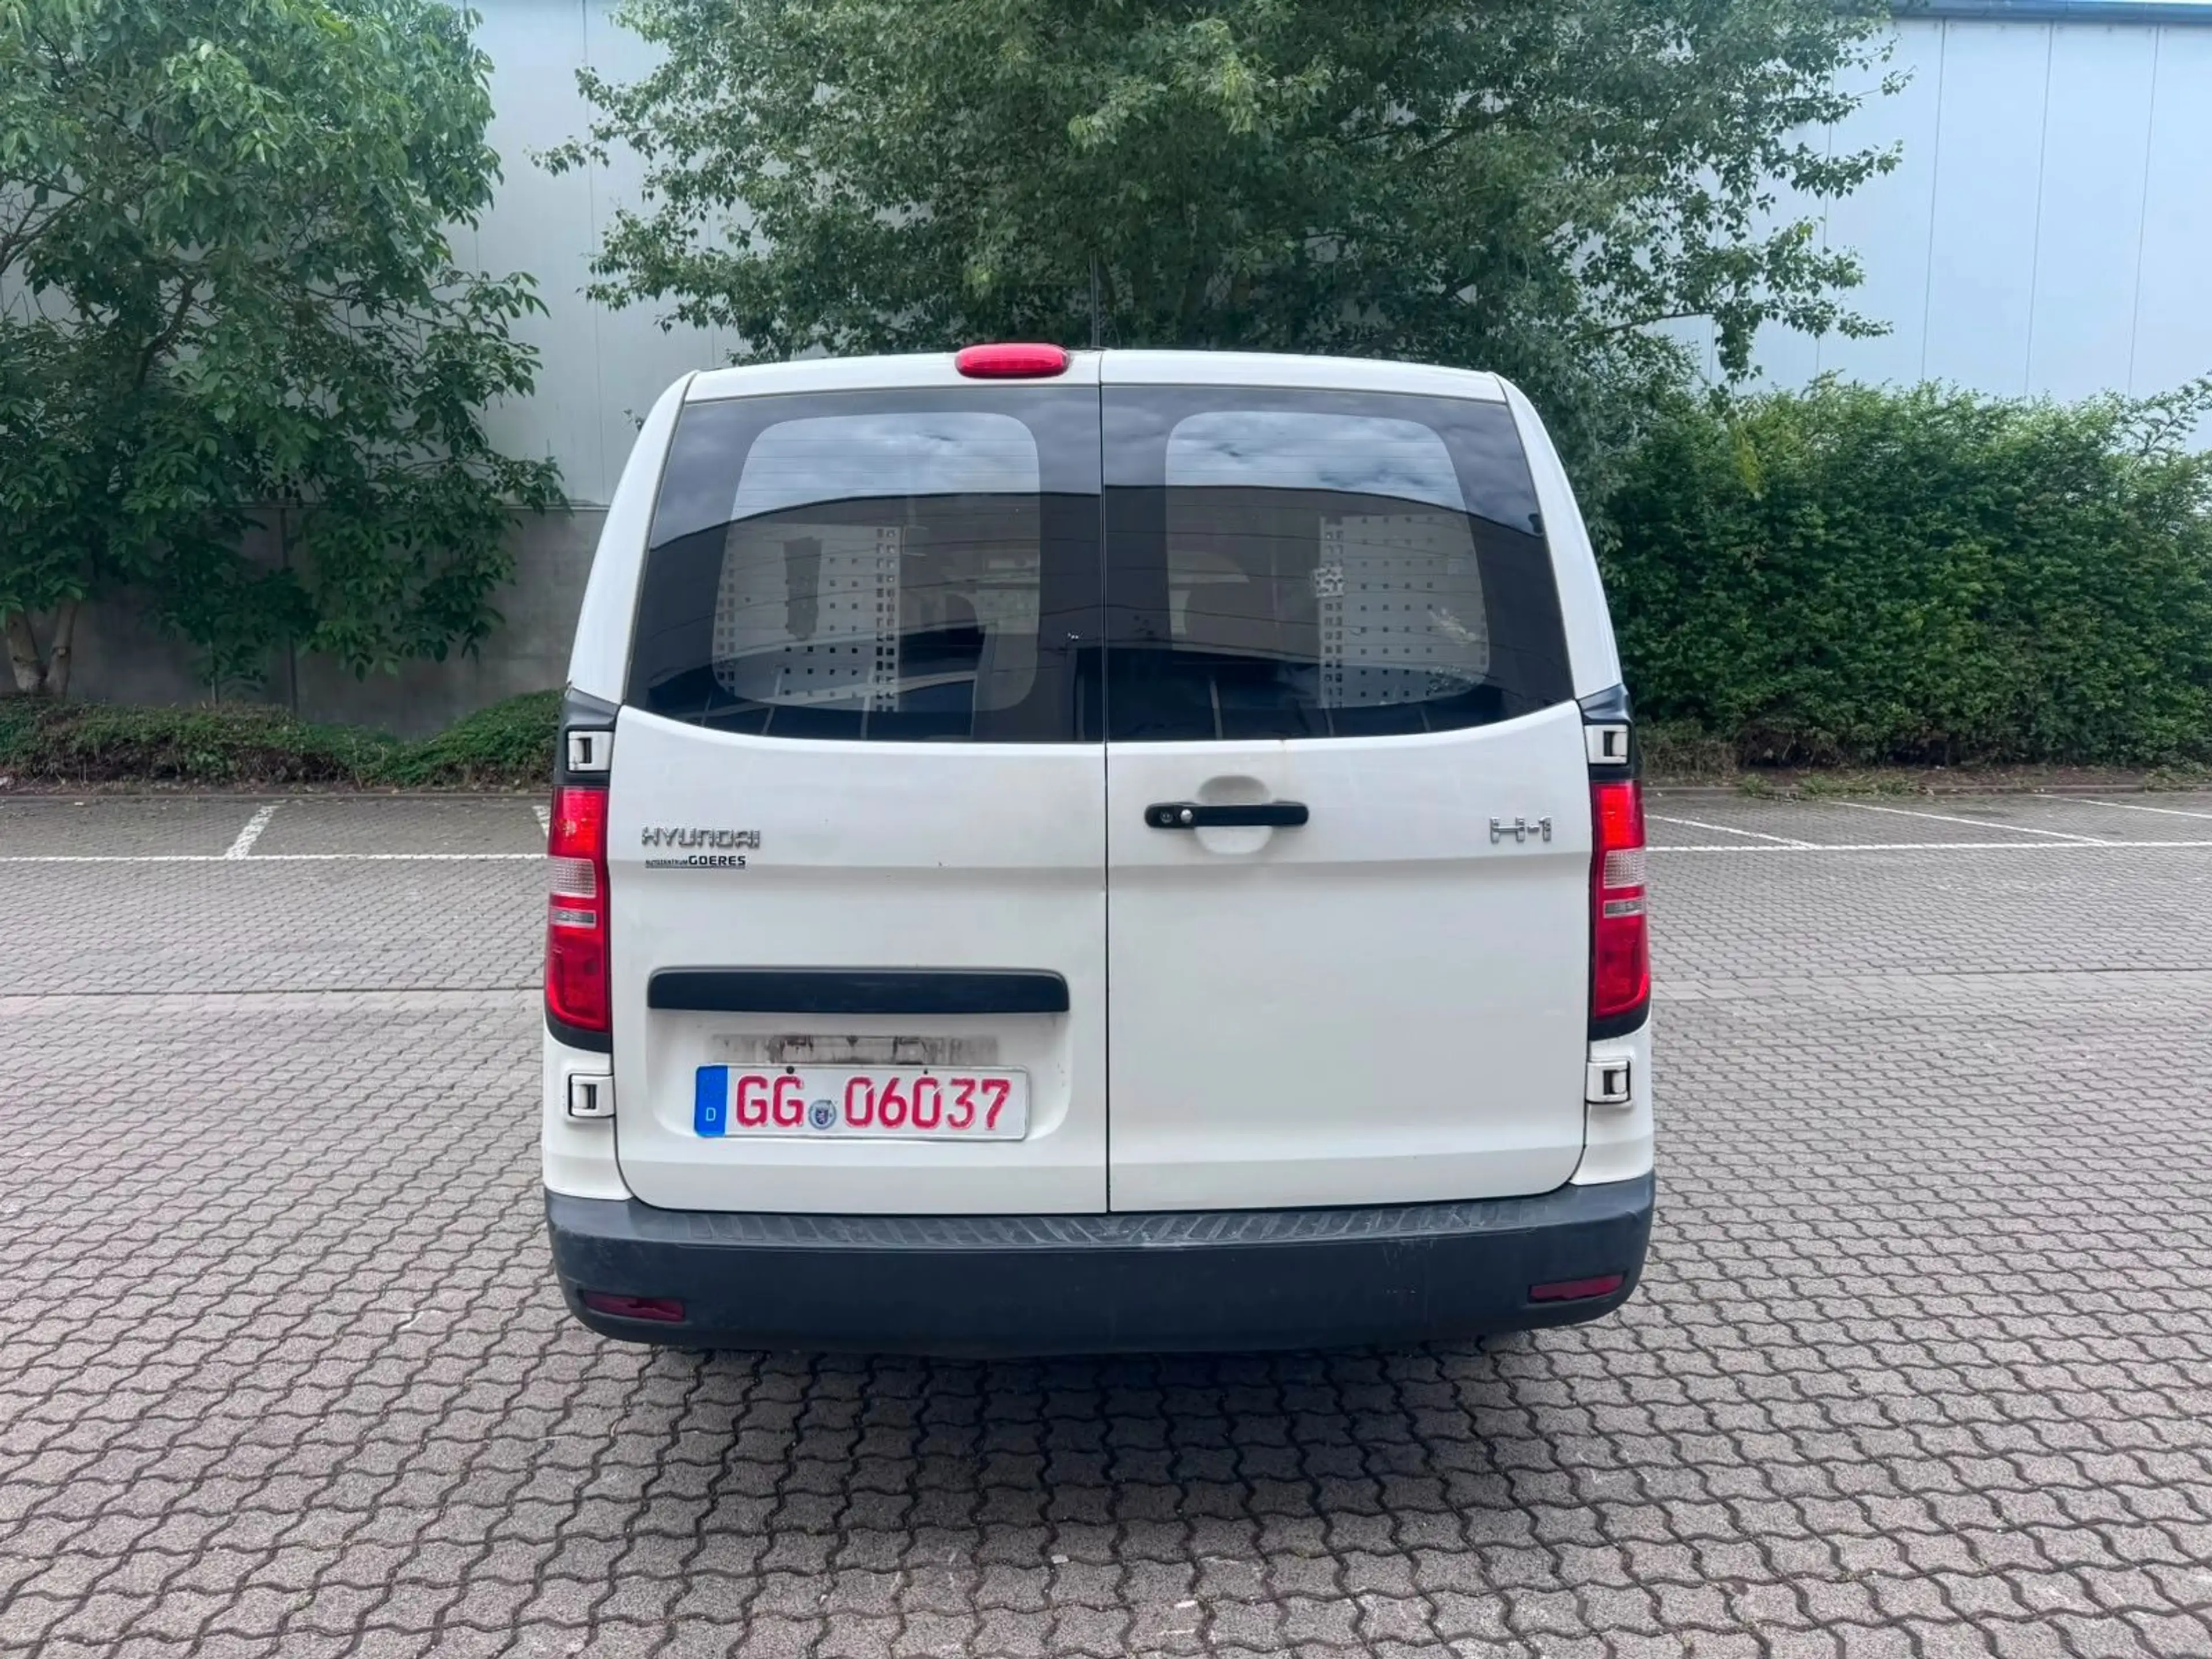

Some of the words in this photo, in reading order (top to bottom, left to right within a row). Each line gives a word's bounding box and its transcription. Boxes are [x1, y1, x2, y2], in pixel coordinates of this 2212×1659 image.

[642, 827, 760, 849] HYUNDAI
[1490, 816, 1551, 844] H-1
[688, 855, 746, 866] GOERES
[736, 1075, 804, 1128] GG
[844, 1076, 1012, 1130] 06037
[706, 1107, 716, 1122] D
